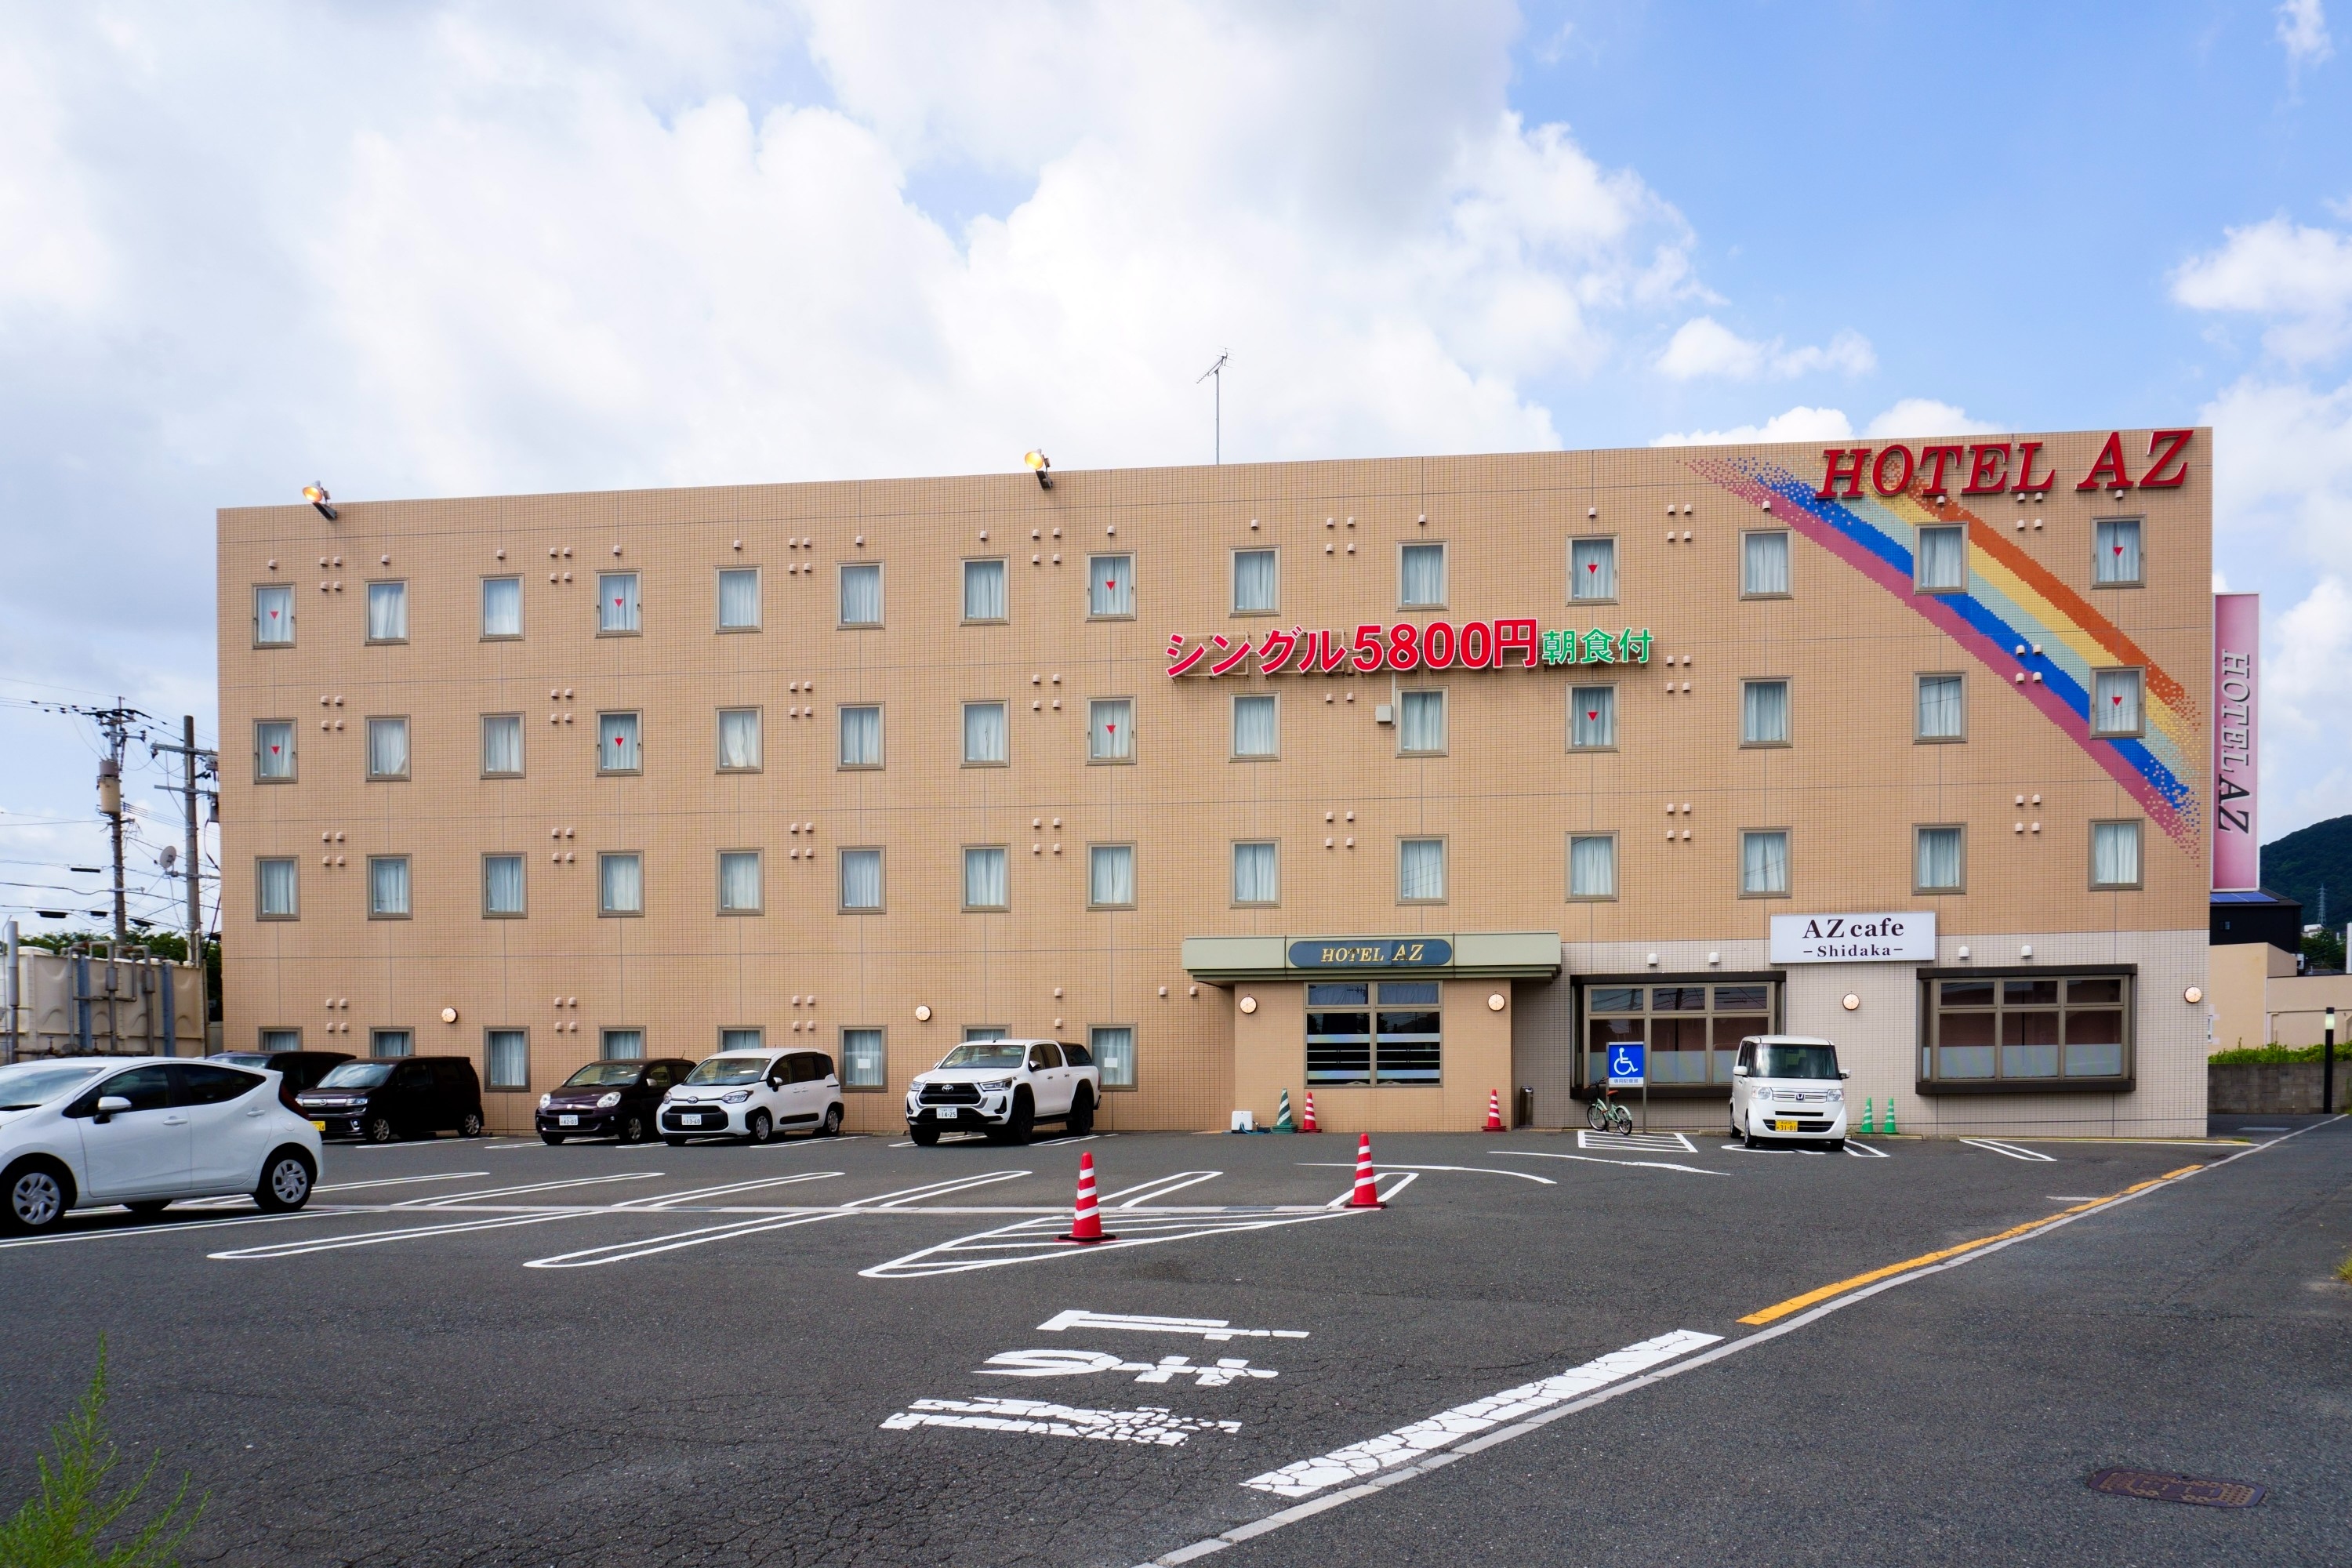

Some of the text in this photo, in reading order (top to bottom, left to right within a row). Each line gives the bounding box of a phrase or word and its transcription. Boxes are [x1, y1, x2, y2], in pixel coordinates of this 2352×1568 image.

[1815, 429, 2194, 499] HOTEL AZ
[2218, 648, 2251, 836] HOTEL AZ
[1802, 917, 1904, 938] AZ cafe
[1320, 944, 1425, 963] HOTEL AZ
